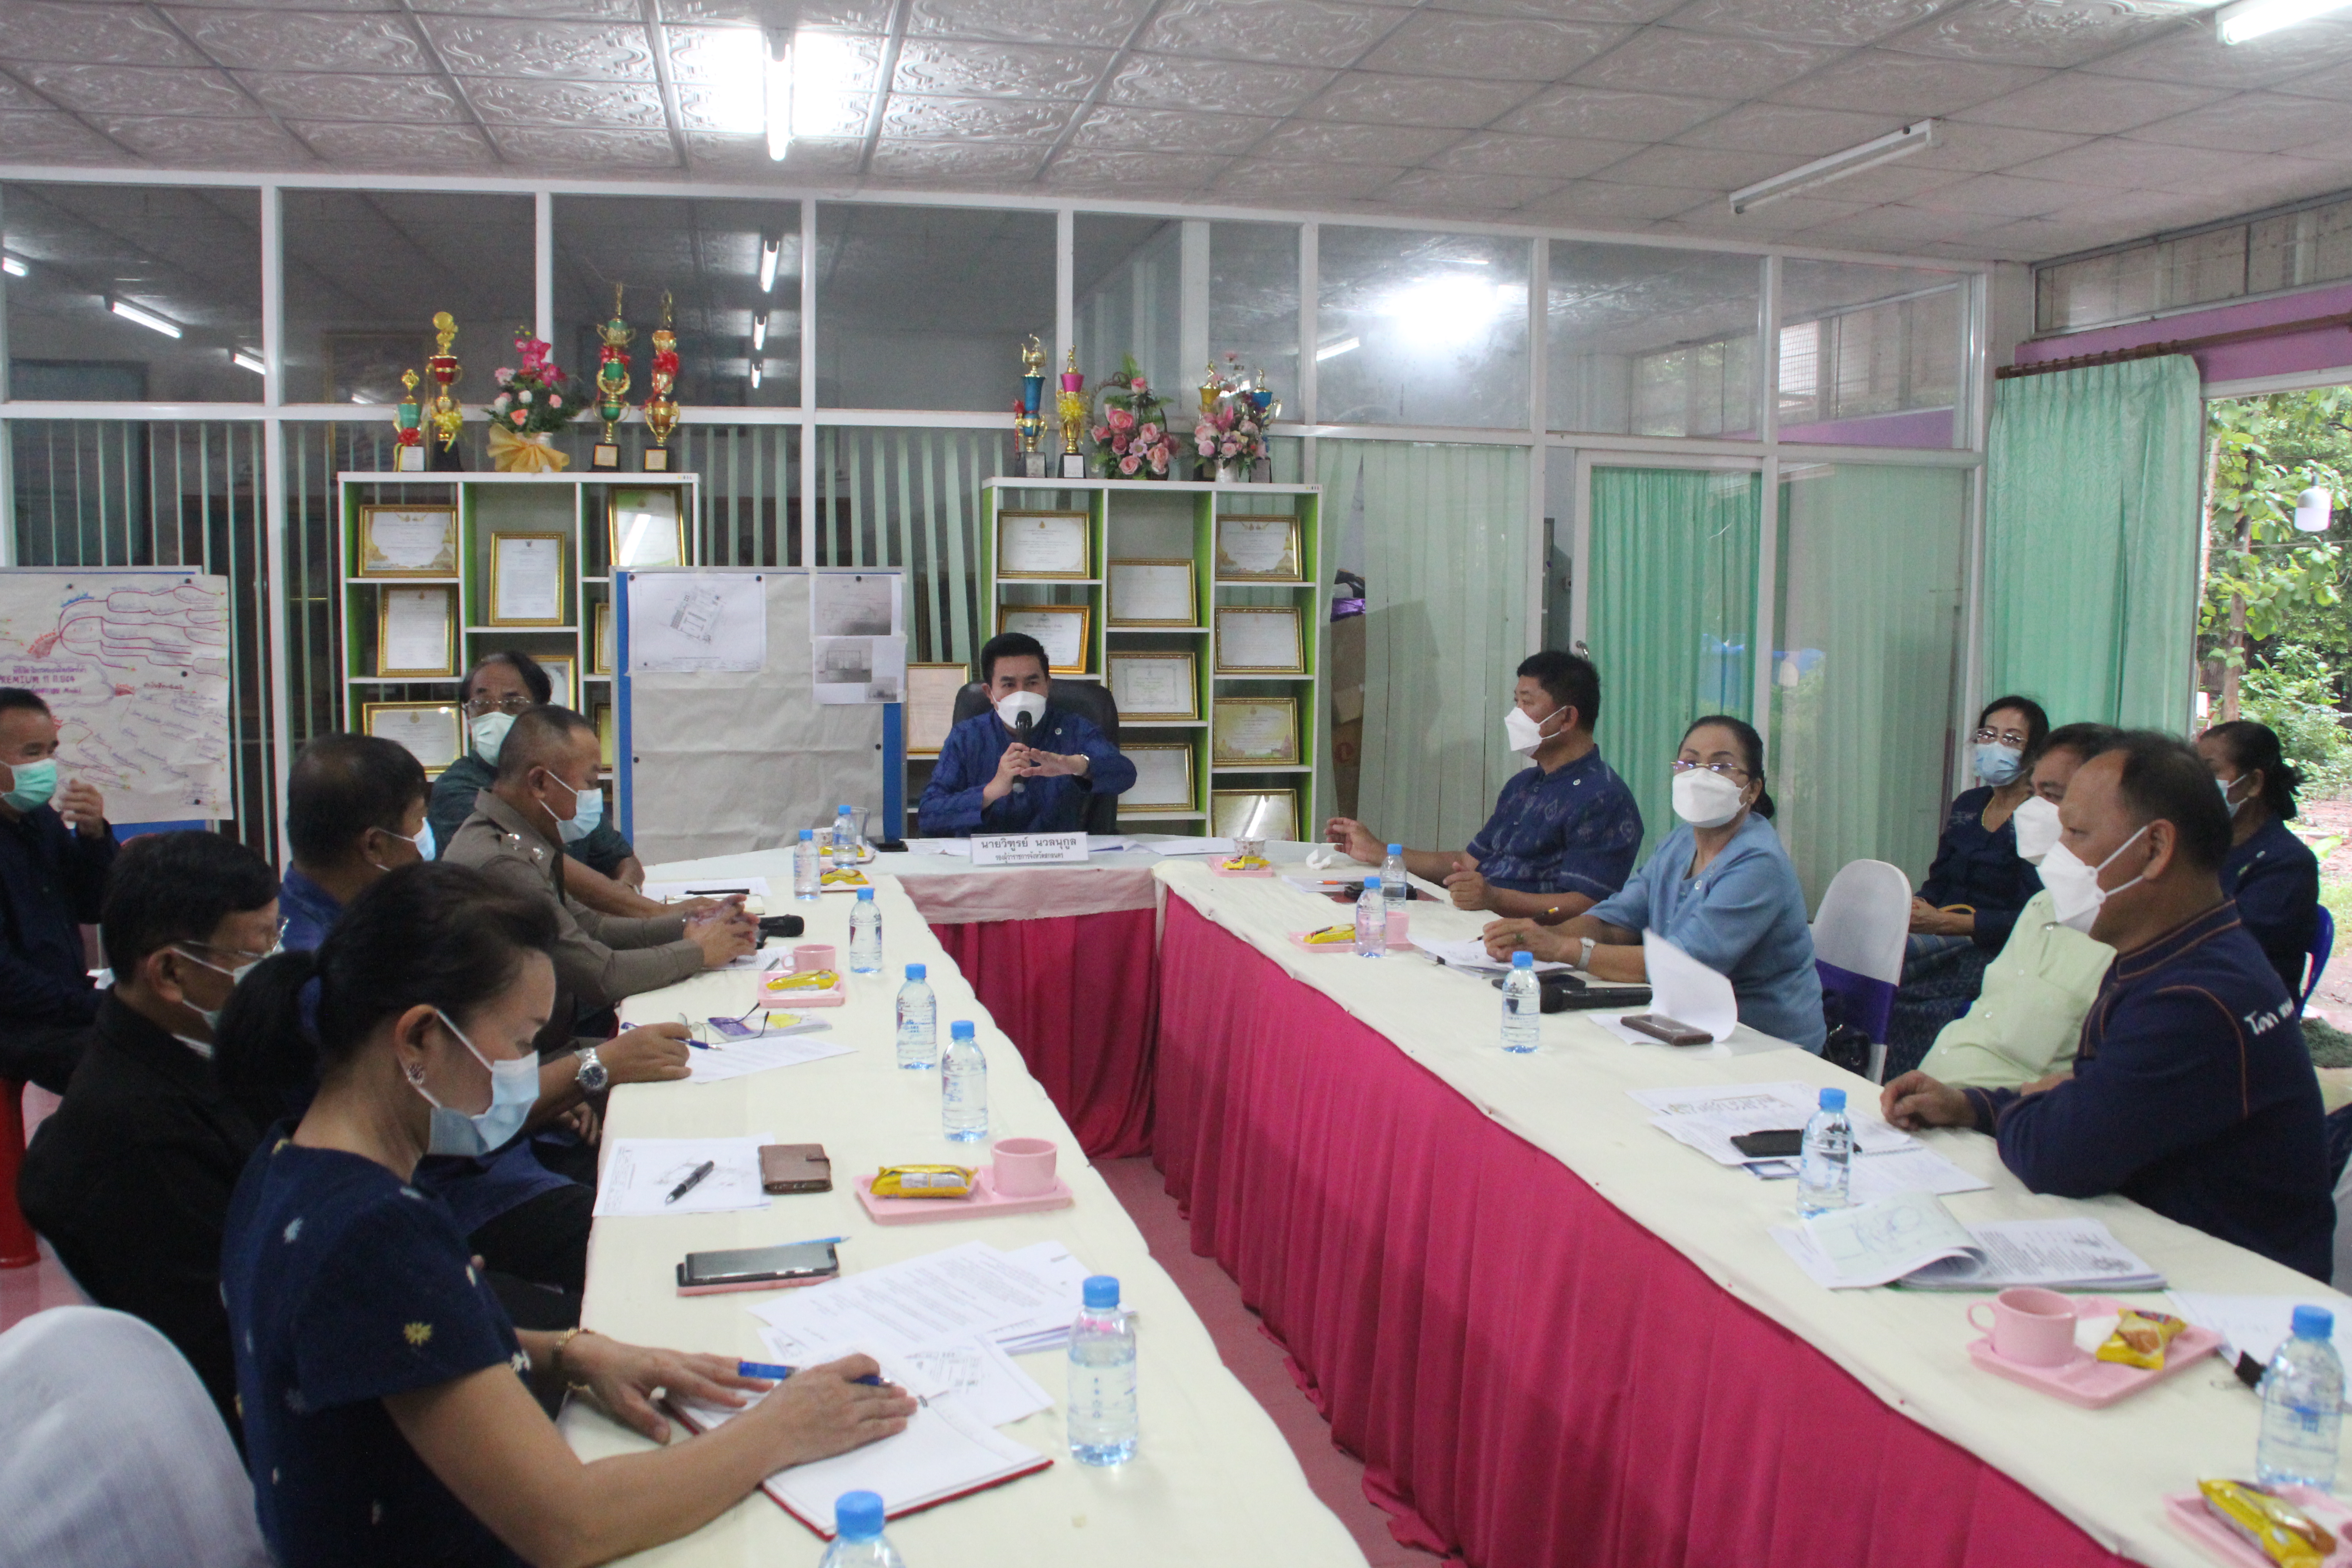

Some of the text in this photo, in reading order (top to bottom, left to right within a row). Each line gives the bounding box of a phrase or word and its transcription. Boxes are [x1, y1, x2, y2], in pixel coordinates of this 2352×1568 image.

[981, 836, 1077, 851] นายวิฑูรย์ นวลนุกูล
[995, 851, 1064, 863] รองผู้ว่าราชการจังหวัดสกลนคร
